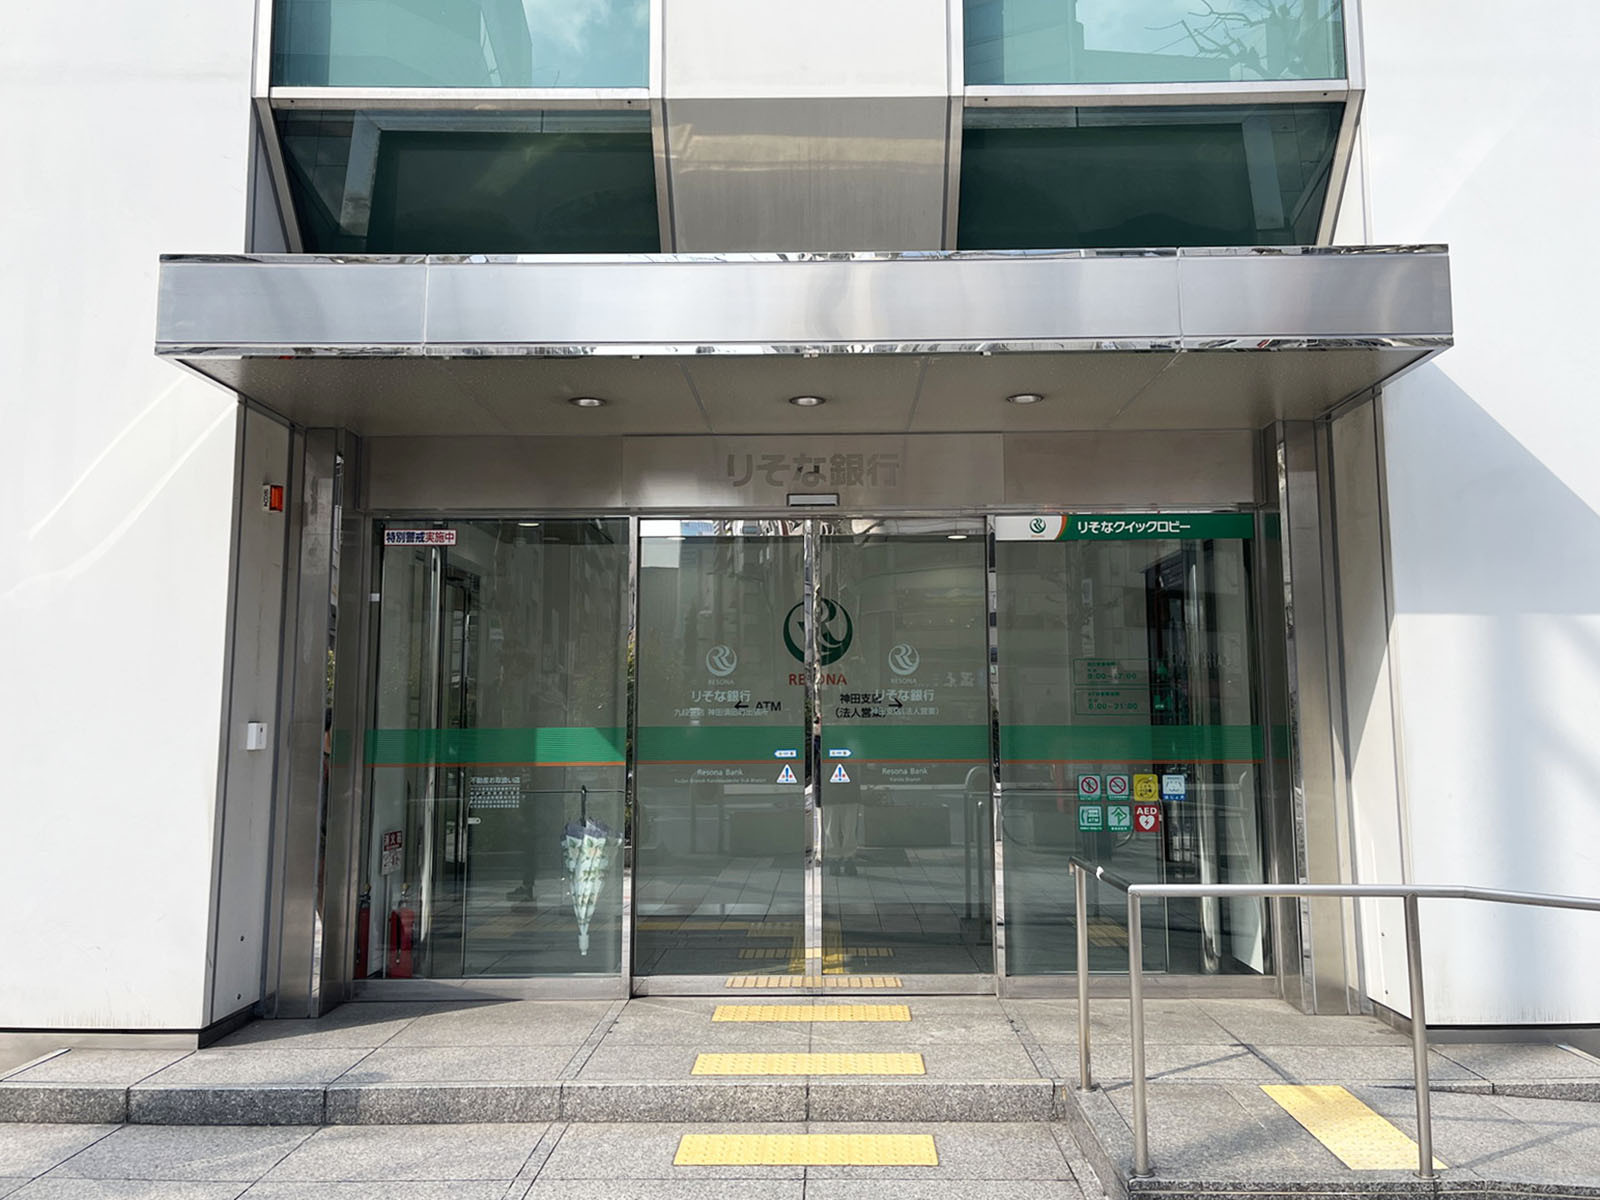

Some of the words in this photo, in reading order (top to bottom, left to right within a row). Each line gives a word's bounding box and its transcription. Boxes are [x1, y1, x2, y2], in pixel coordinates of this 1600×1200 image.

[727, 453, 900, 487] りそな銀行
[1077, 520, 1191, 533] りそなクイックロビー
[386, 531, 455, 543] 特別警戒実施中
[788, 673, 848, 685] RENA
[691, 690, 751, 702] りそな銀行
[875, 689, 935, 702] りそな銀行
[755, 701, 782, 711] ATM
[882, 767, 908, 775] Resona
[910, 767, 929, 775] Bank
[1136, 807, 1158, 815] AED
